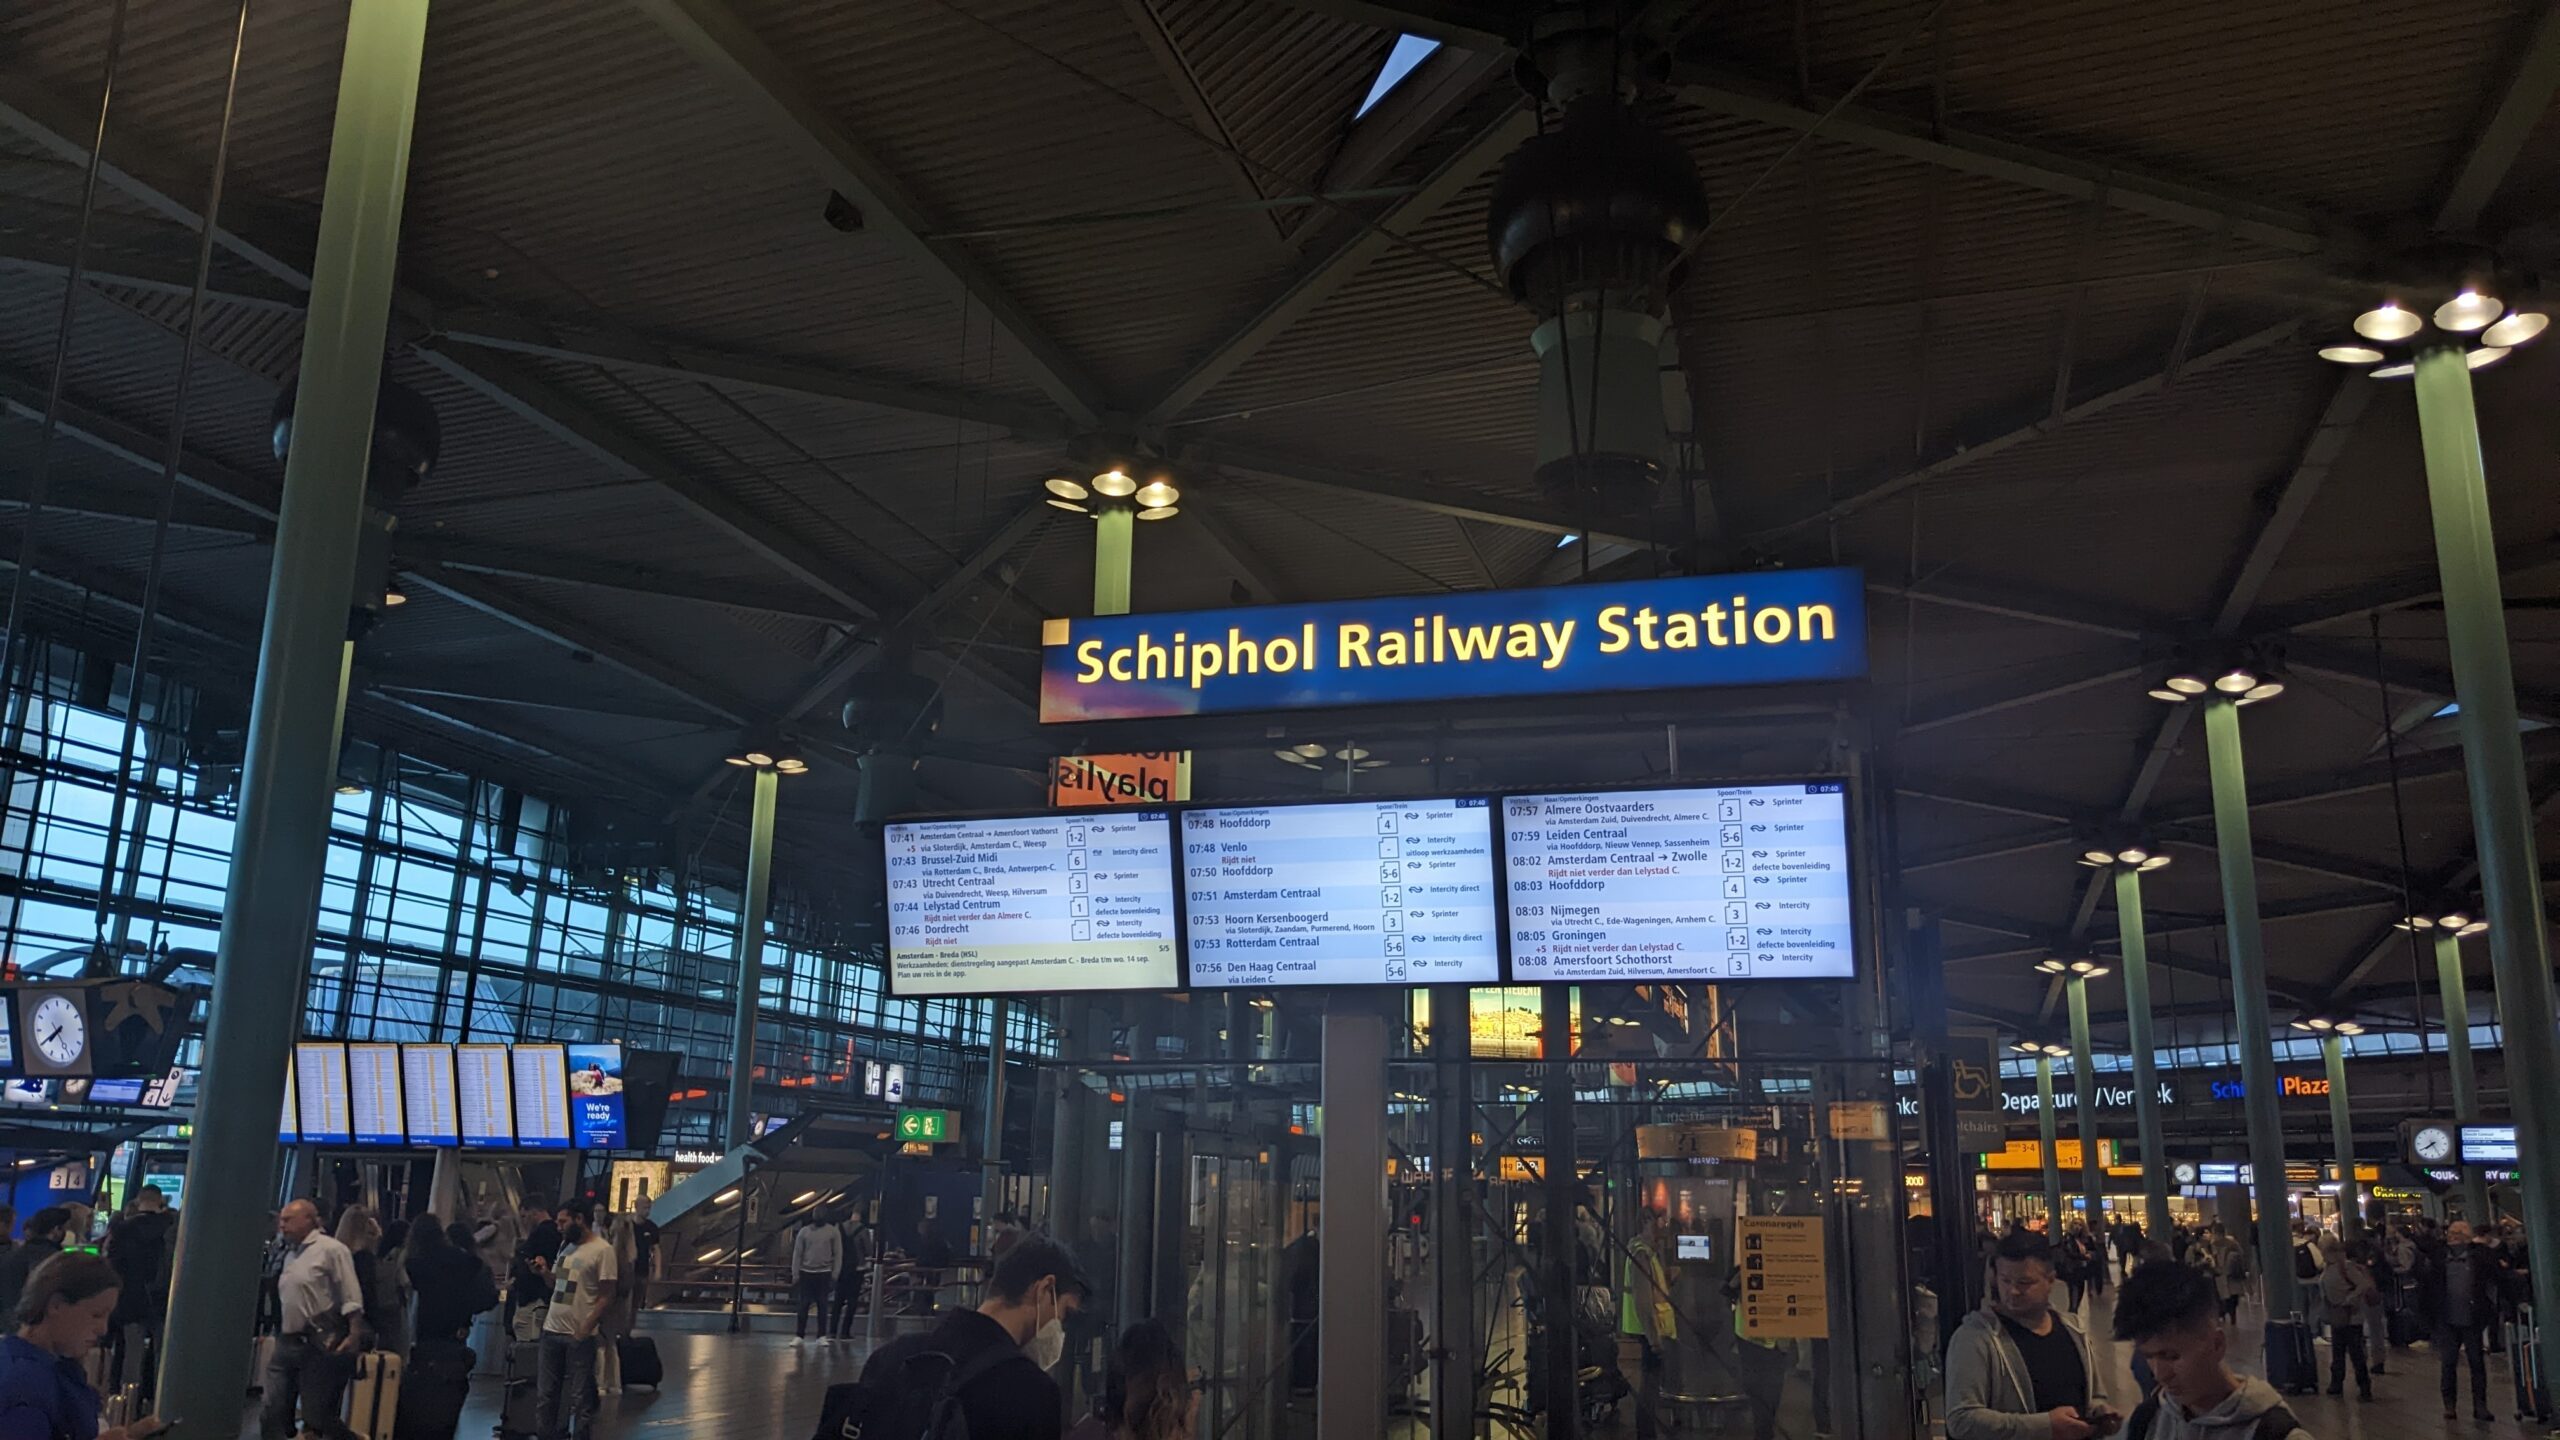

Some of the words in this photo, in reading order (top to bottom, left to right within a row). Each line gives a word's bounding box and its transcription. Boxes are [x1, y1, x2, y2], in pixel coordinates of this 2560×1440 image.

[1075, 624, 1315, 688] Schiphol
[1338, 616, 1575, 671] Railway
[1597, 597, 1836, 654] Station
[1820, 785, 1839, 793] 07:40
[1773, 797, 1803, 807] Sprinter
[1510, 804, 1538, 816] 07:57
[1544, 803, 1581, 815] Almere
[1584, 801, 1654, 813] Oostvaarders
[1426, 811, 1453, 820] Sprinter
[1546, 817, 1556, 825] via
[1557, 816, 1599, 825] Amsterdam
[1600, 815, 1618, 824] Zuid,
[1620, 814, 1671, 823] Duivendrecht,
[1187, 817, 1214, 829] 07:48
[1218, 816, 1270, 830] Hoofddorp
[1774, 823, 1804, 832] Sprinter
[891, 832, 914, 843] 07:41
[1512, 830, 1540, 841] 07:59
[1547, 829, 1580, 840] Leiden
[1583, 827, 1627, 839] Centraal
[1723, 832, 1740, 843] 5-6
[1428, 836, 1456, 845] Intercity
[1548, 842, 1558, 851] via
[1559, 841, 1603, 851] Hoofddorp,
[1604, 840, 1629, 849] Nieuw
[1630, 840, 1662, 849] Vennep,
[1663, 838, 1710, 847] Sassenheim
[1189, 843, 1215, 854] 07:48
[1221, 841, 1247, 852] Venlo
[1406, 849, 1430, 857] uitloop
[1430, 847, 1486, 856] werkzaamheden
[921, 853, 975, 865] Brussel-Zuid
[1549, 853, 1607, 865] Amsterdam
[1609, 852, 1654, 863] Centraal
[1671, 850, 1707, 861] Zwolle
[1776, 849, 1806, 859] Sprinter
[1222, 855, 1239, 866] Rijdt
[1240, 855, 1256, 863] niet
[1429, 860, 1456, 869] Sprinter
[1513, 855, 1541, 866] 08:02
[1725, 858, 1742, 868] 1-2
[1189, 867, 1216, 877] 07:50
[1223, 864, 1273, 878] Hoofddorp
[1752, 862, 1780, 871] defecte
[1781, 861, 1831, 872] bovenleiding
[1382, 868, 1398, 879] 5-6
[1548, 868, 1568, 879] Rijdt
[1569, 868, 1586, 877] niet
[1587, 867, 1615, 876] verder
[1616, 867, 1632, 875] dan
[1634, 866, 1669, 877] Lelystad
[923, 877, 955, 888] Utrecht
[957, 875, 994, 886] Centraal
[1549, 878, 1605, 892] Hoofddorp
[1777, 875, 1807, 884] Sprinter
[1431, 885, 1458, 894] Intercity
[1459, 884, 1480, 892] direct
[1514, 880, 1543, 891] 08:03
[1192, 891, 1217, 901] 07:51
[1224, 888, 1278, 900] Amsterdam
[1280, 887, 1320, 898] Centraal
[1384, 892, 1399, 903] 1-2
[923, 900, 960, 913] Lelystad
[1516, 905, 1544, 916] 08:03
[1551, 904, 1600, 918] Nijmegen
[1779, 901, 1810, 910] Intercity
[1225, 913, 1254, 924] Hoorn
[1256, 911, 1328, 925] Kersenboogerd
[1432, 909, 1459, 918] Sprinter
[1193, 915, 1219, 925] 07:53
[1552, 918, 1562, 926] via
[1563, 917, 1593, 925] Utrecht
[1594, 917, 1604, 926] C.,
[1606, 916, 1673, 926] Ede-Wageningen,
[1675, 915, 1706, 923] Arnhem
[925, 923, 969, 934] Dordrecht
[1225, 926, 1237, 935] via
[1236, 925, 1273, 935] Sloterdijk,
[1274, 924, 1309, 933] Zaandam,
[1310, 924, 1351, 932] Purmerend,
[1781, 927, 1812, 937] Intercity
[1433, 934, 1461, 943] Intercity
[1462, 933, 1483, 941] direct
[1517, 930, 1545, 941] 08:05
[1552, 929, 1606, 943] Groningen
[1729, 935, 1746, 945] 1-2
[1193, 938, 1220, 949] 07:53
[1226, 937, 1277, 948] Rotterdam
[1278, 936, 1319, 947] Centraal
[1386, 942, 1402, 952] 5-6
[1757, 940, 1785, 948] defecte
[1786, 940, 1835, 950] bovenleiding
[1435, 959, 1463, 968] Intercity
[1519, 955, 1547, 966] 08:08
[1553, 954, 1612, 965] Amersfoort
[1615, 953, 1672, 964] Schothorst
[1782, 953, 1813, 963] Intercity
[1195, 962, 1222, 973] 07:56
[1228, 962, 1246, 972] Den
[1248, 961, 1273, 974] Haag
[1275, 960, 1316, 971] Centraal
[1388, 966, 1404, 977] 5-6
[1229, 975, 1240, 984] via
[1240, 975, 1266, 984] Leiden
[587, 1112, 610, 1121] ready
[675, 1150, 697, 1163] health
[698, 1151, 715, 1164] food
